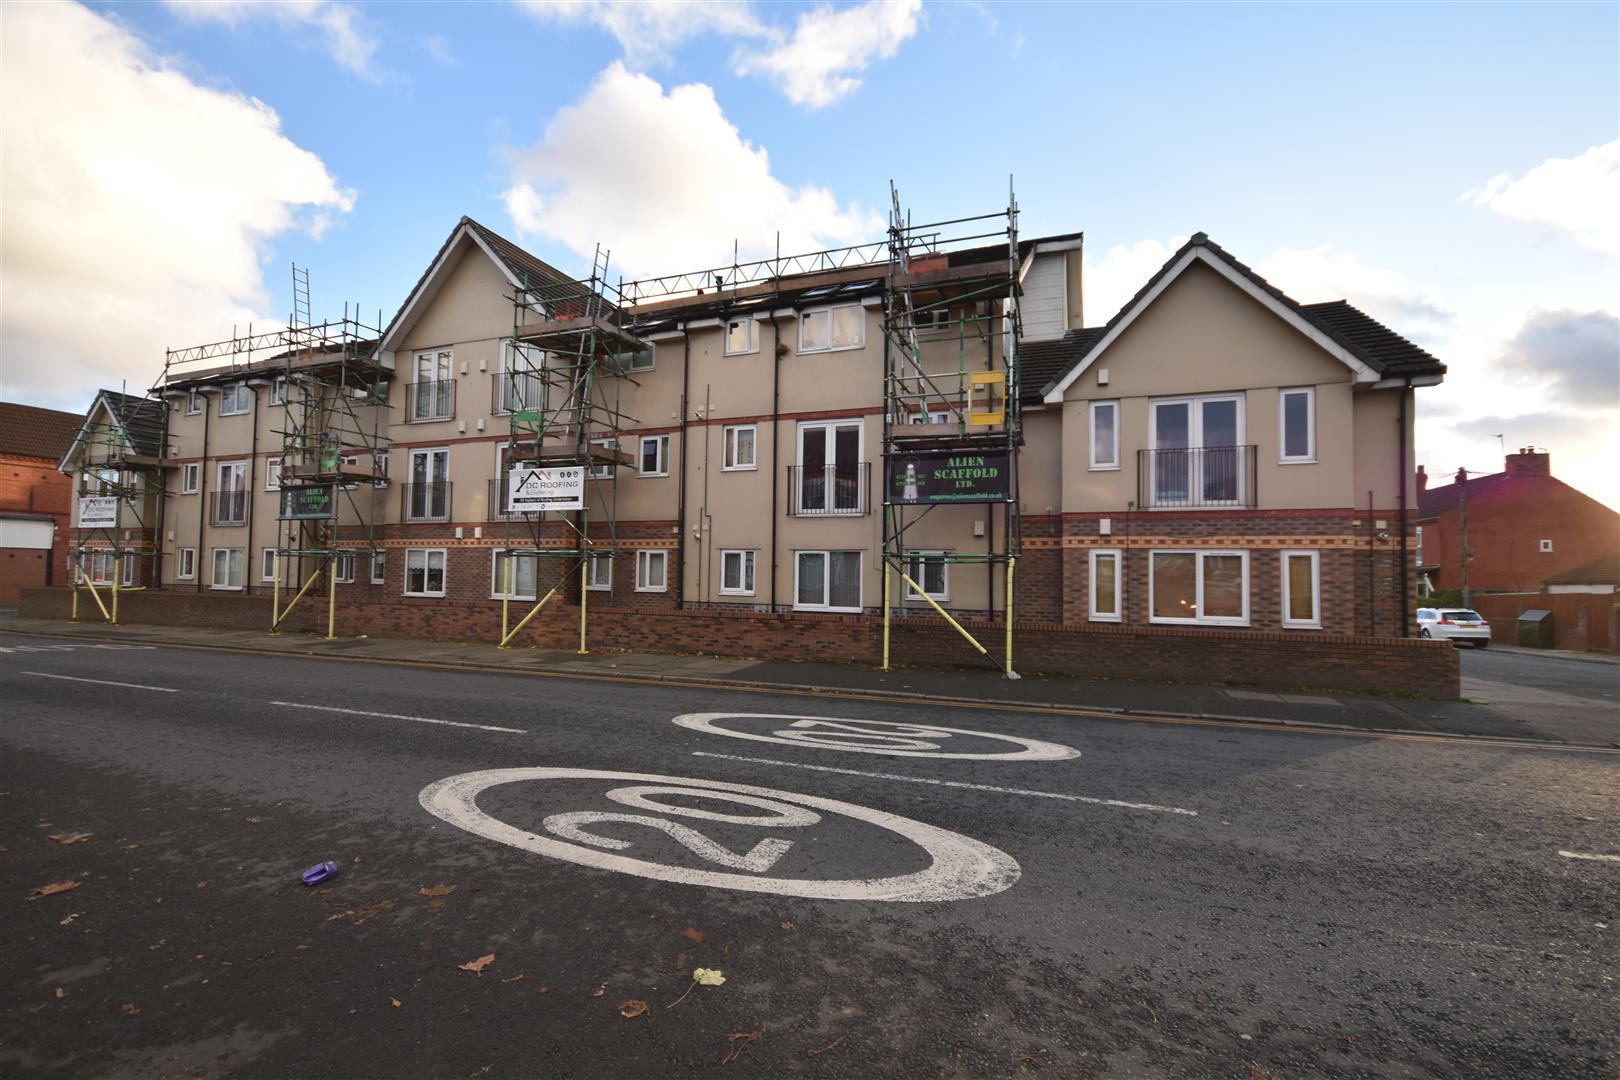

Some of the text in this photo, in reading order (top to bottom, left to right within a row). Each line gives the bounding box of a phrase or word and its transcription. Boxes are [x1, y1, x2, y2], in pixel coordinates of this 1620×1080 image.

[946, 456, 985, 467] ALIEN
[934, 468, 998, 479] SCAFFOLD
[540, 481, 579, 489] ROOFING
[955, 480, 975, 488] LTD.
[541, 785, 823, 873] 20
